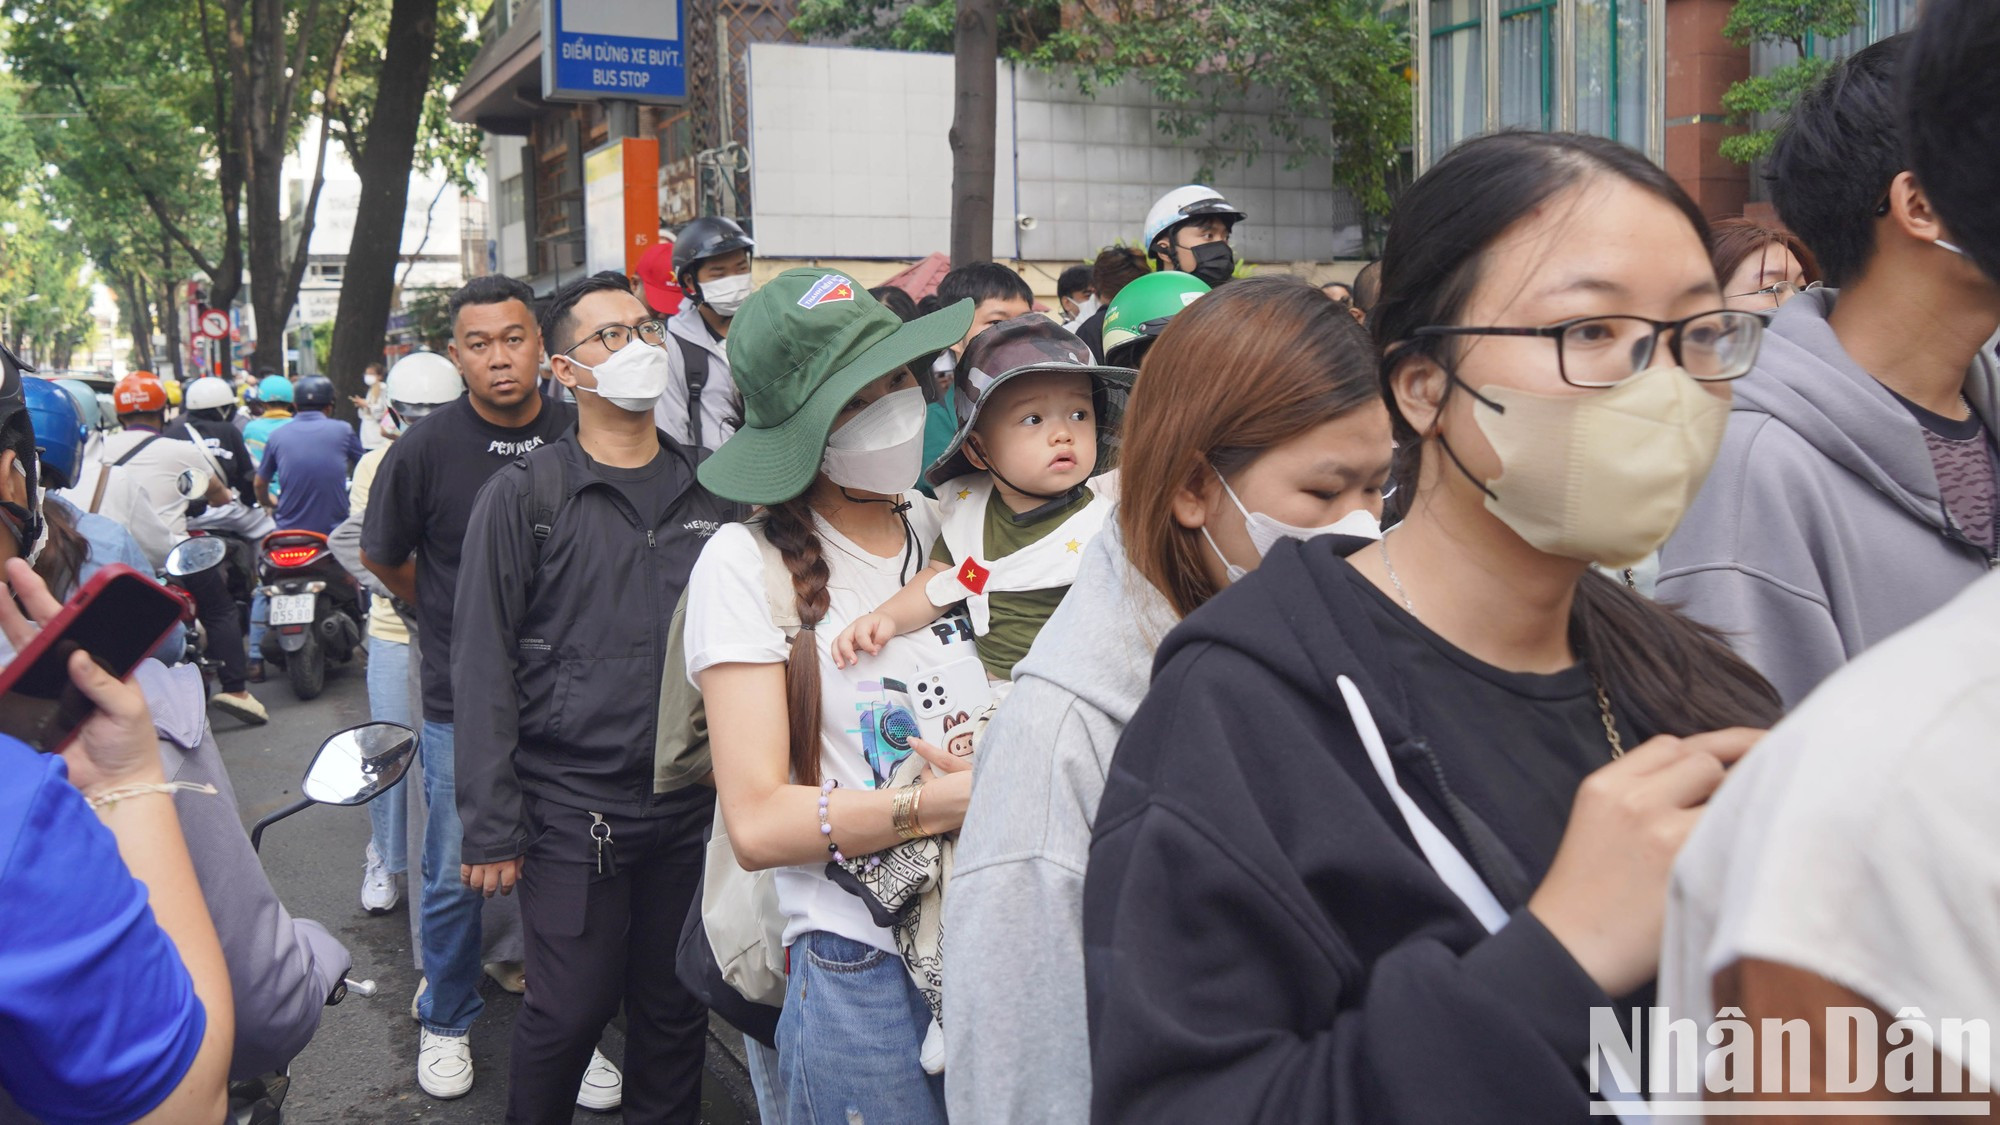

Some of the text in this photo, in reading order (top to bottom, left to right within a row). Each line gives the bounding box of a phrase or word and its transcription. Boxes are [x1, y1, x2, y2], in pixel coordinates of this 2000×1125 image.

[562, 36, 592, 60] ĐIỂM
[595, 42, 629, 63] DỪNG
[631, 48, 647, 65] XE
[593, 68, 650, 88] BUS STOP
[683, 520, 720, 531] HEROIC
